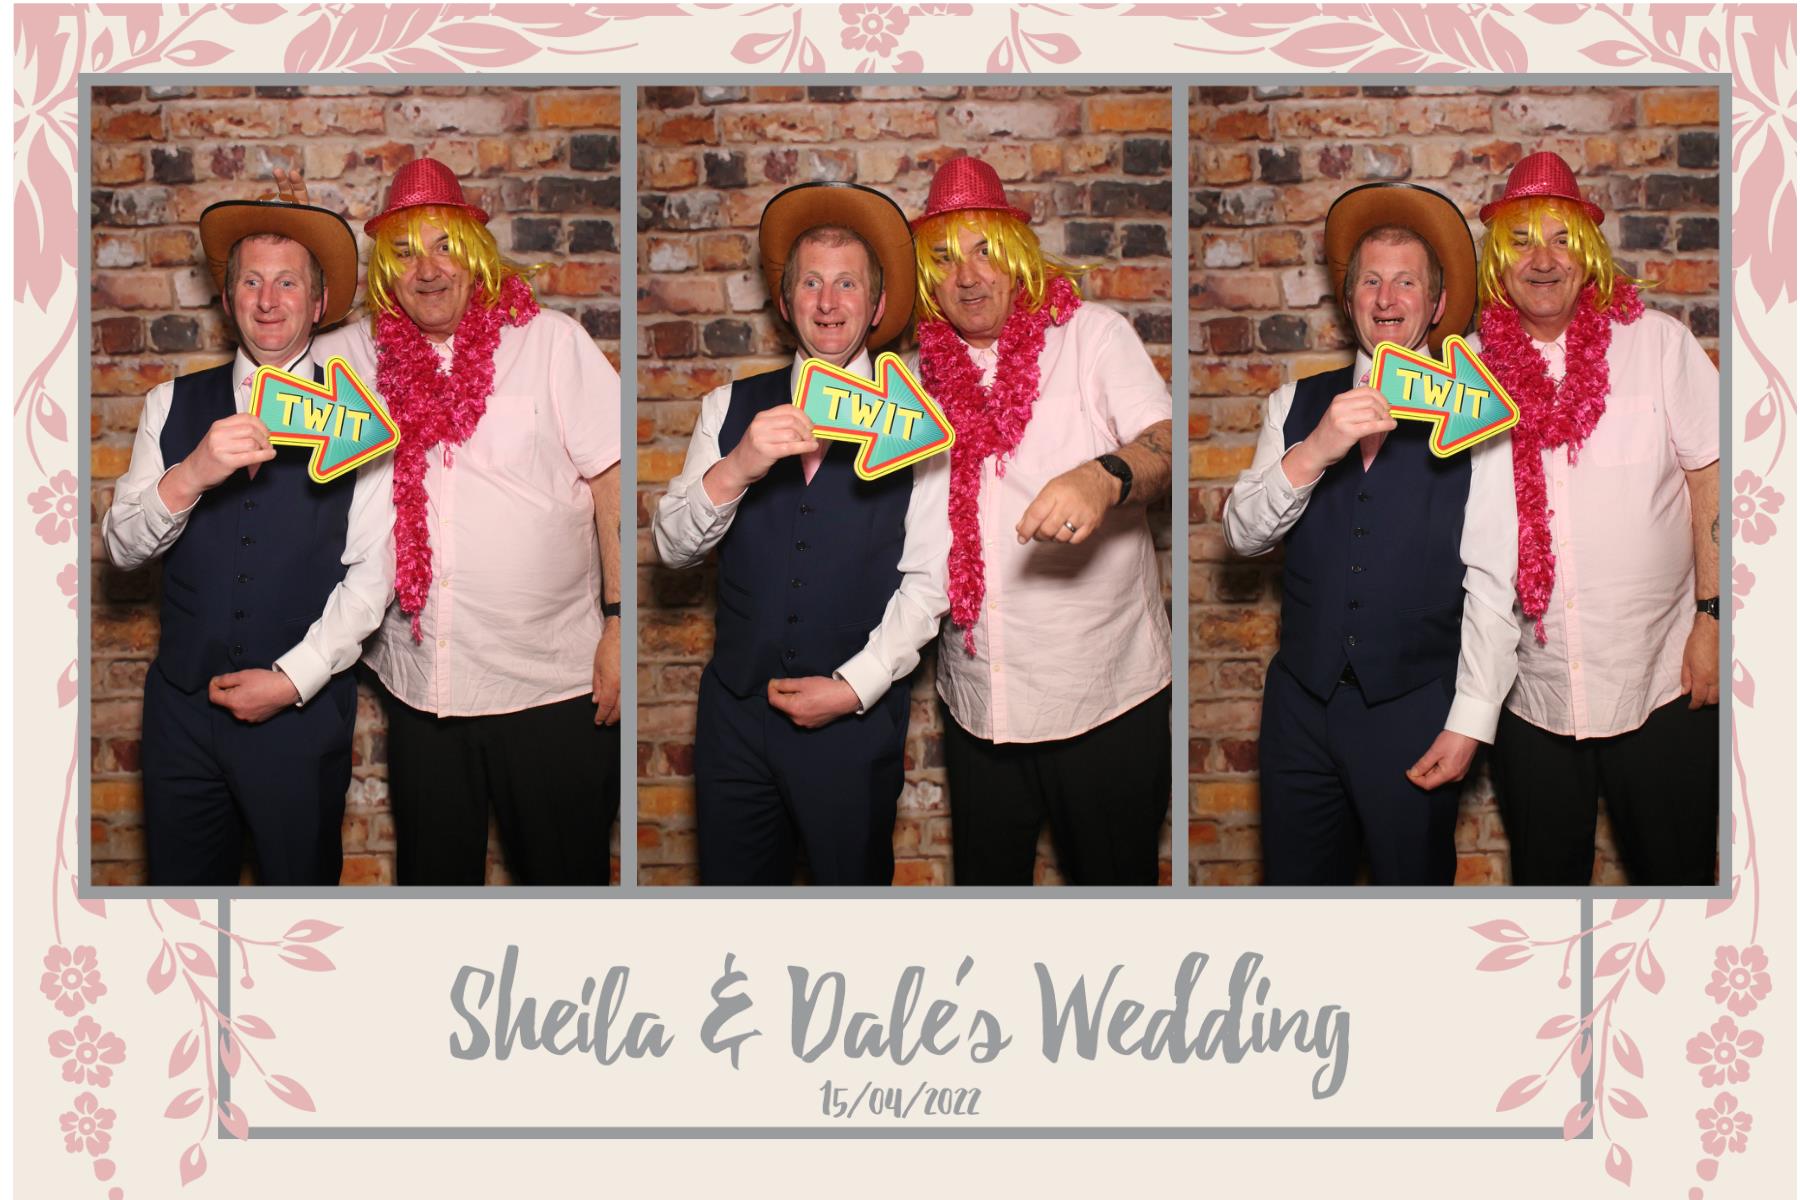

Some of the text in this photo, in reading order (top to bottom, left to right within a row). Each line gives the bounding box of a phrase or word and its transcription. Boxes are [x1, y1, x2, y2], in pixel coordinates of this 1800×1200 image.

[276, 392, 371, 442] TWIT
[823, 386, 924, 441] TWIT
[1396, 368, 1490, 419] TWIT
